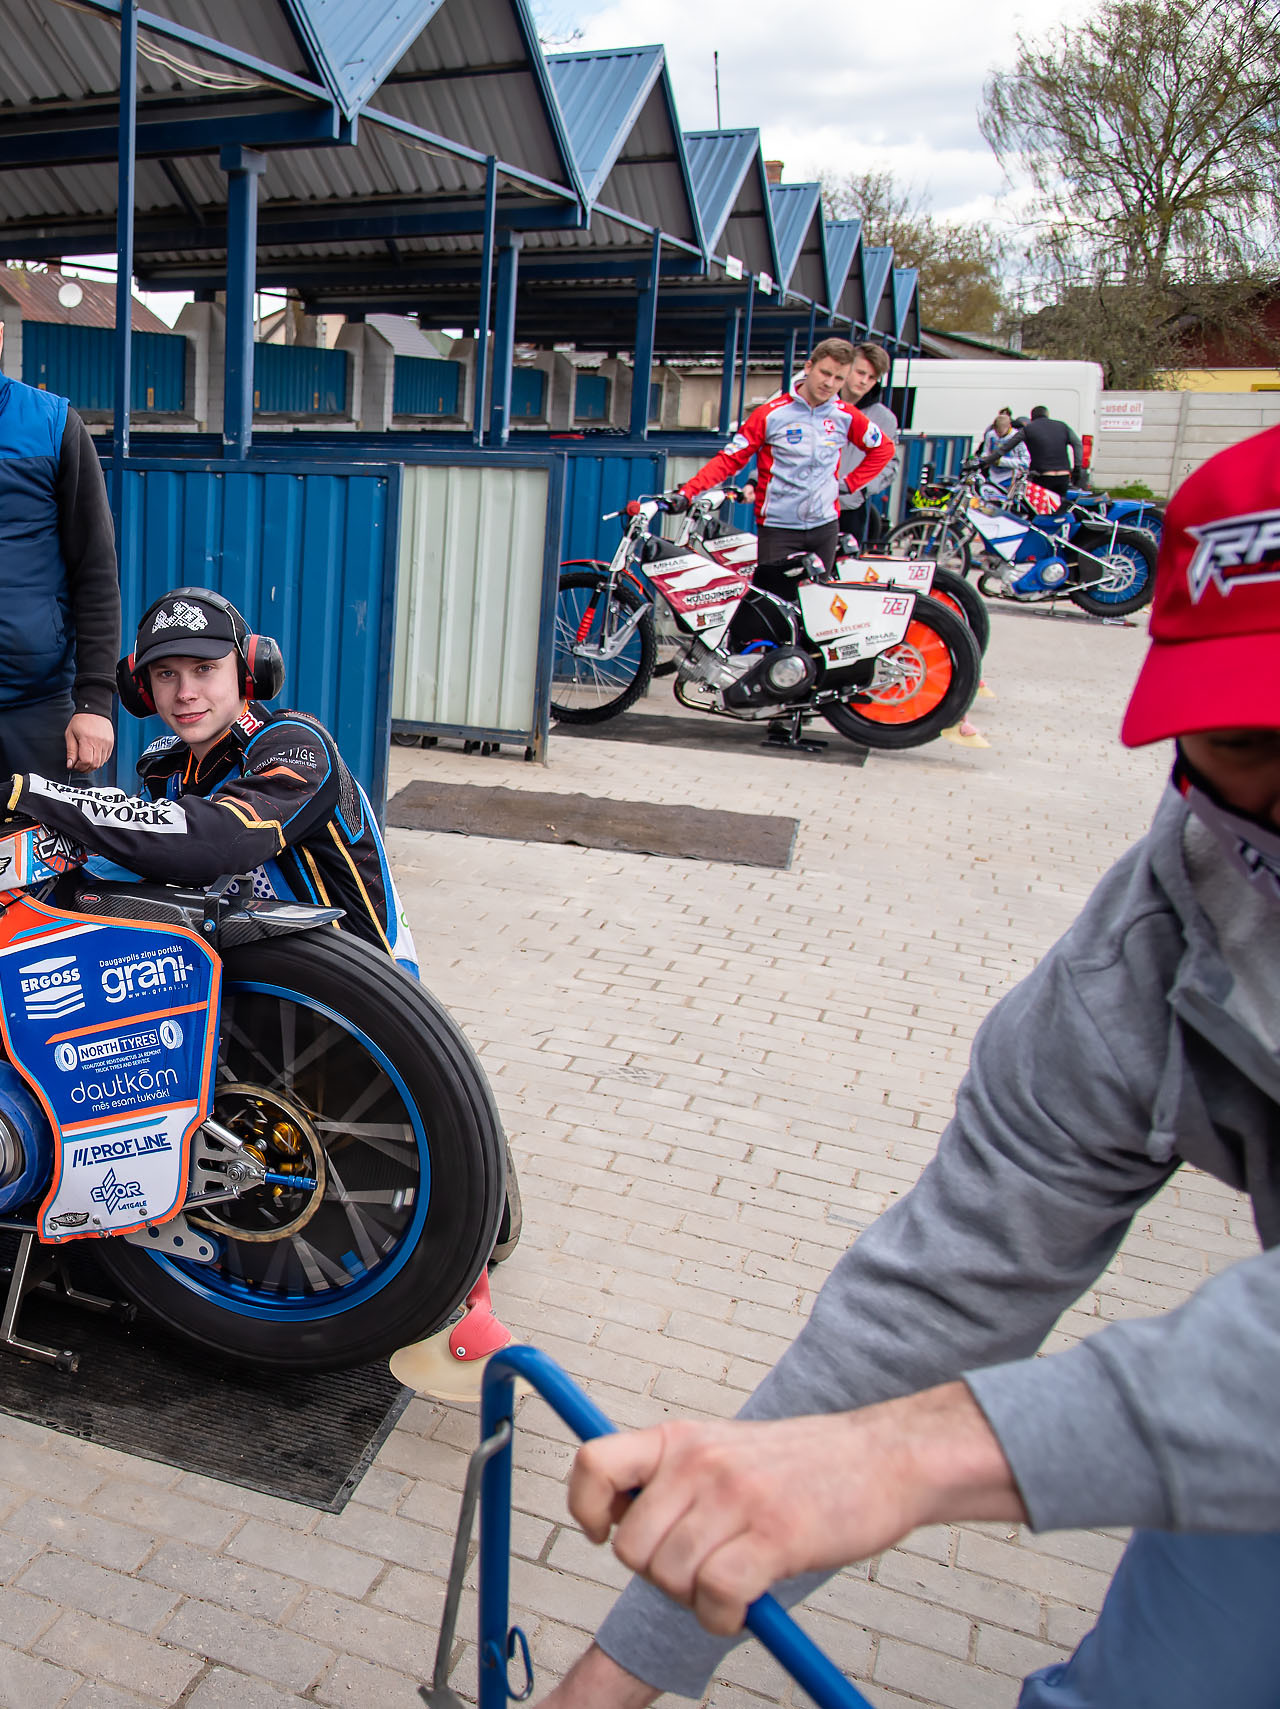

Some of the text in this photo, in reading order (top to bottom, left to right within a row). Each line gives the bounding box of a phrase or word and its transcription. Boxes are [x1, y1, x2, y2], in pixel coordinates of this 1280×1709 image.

[909, 565, 930, 580] 73
[882, 597, 909, 616] 73
[99, 953, 140, 967] Daugavpils
[157, 945, 183, 956] portāls
[21, 968, 81, 992] ERGOSS
[102, 955, 187, 1003] grani
[128, 983, 189, 998] www.grani.lv
[81, 1034, 157, 1060] NORTH TYRES
[132, 1058, 151, 1066] SERVICE
[92, 1101, 110, 1112] mēs
[112, 1097, 137, 1108] esam
[90, 1181, 145, 1203] EVOR
[118, 1200, 148, 1211] LATGALE
